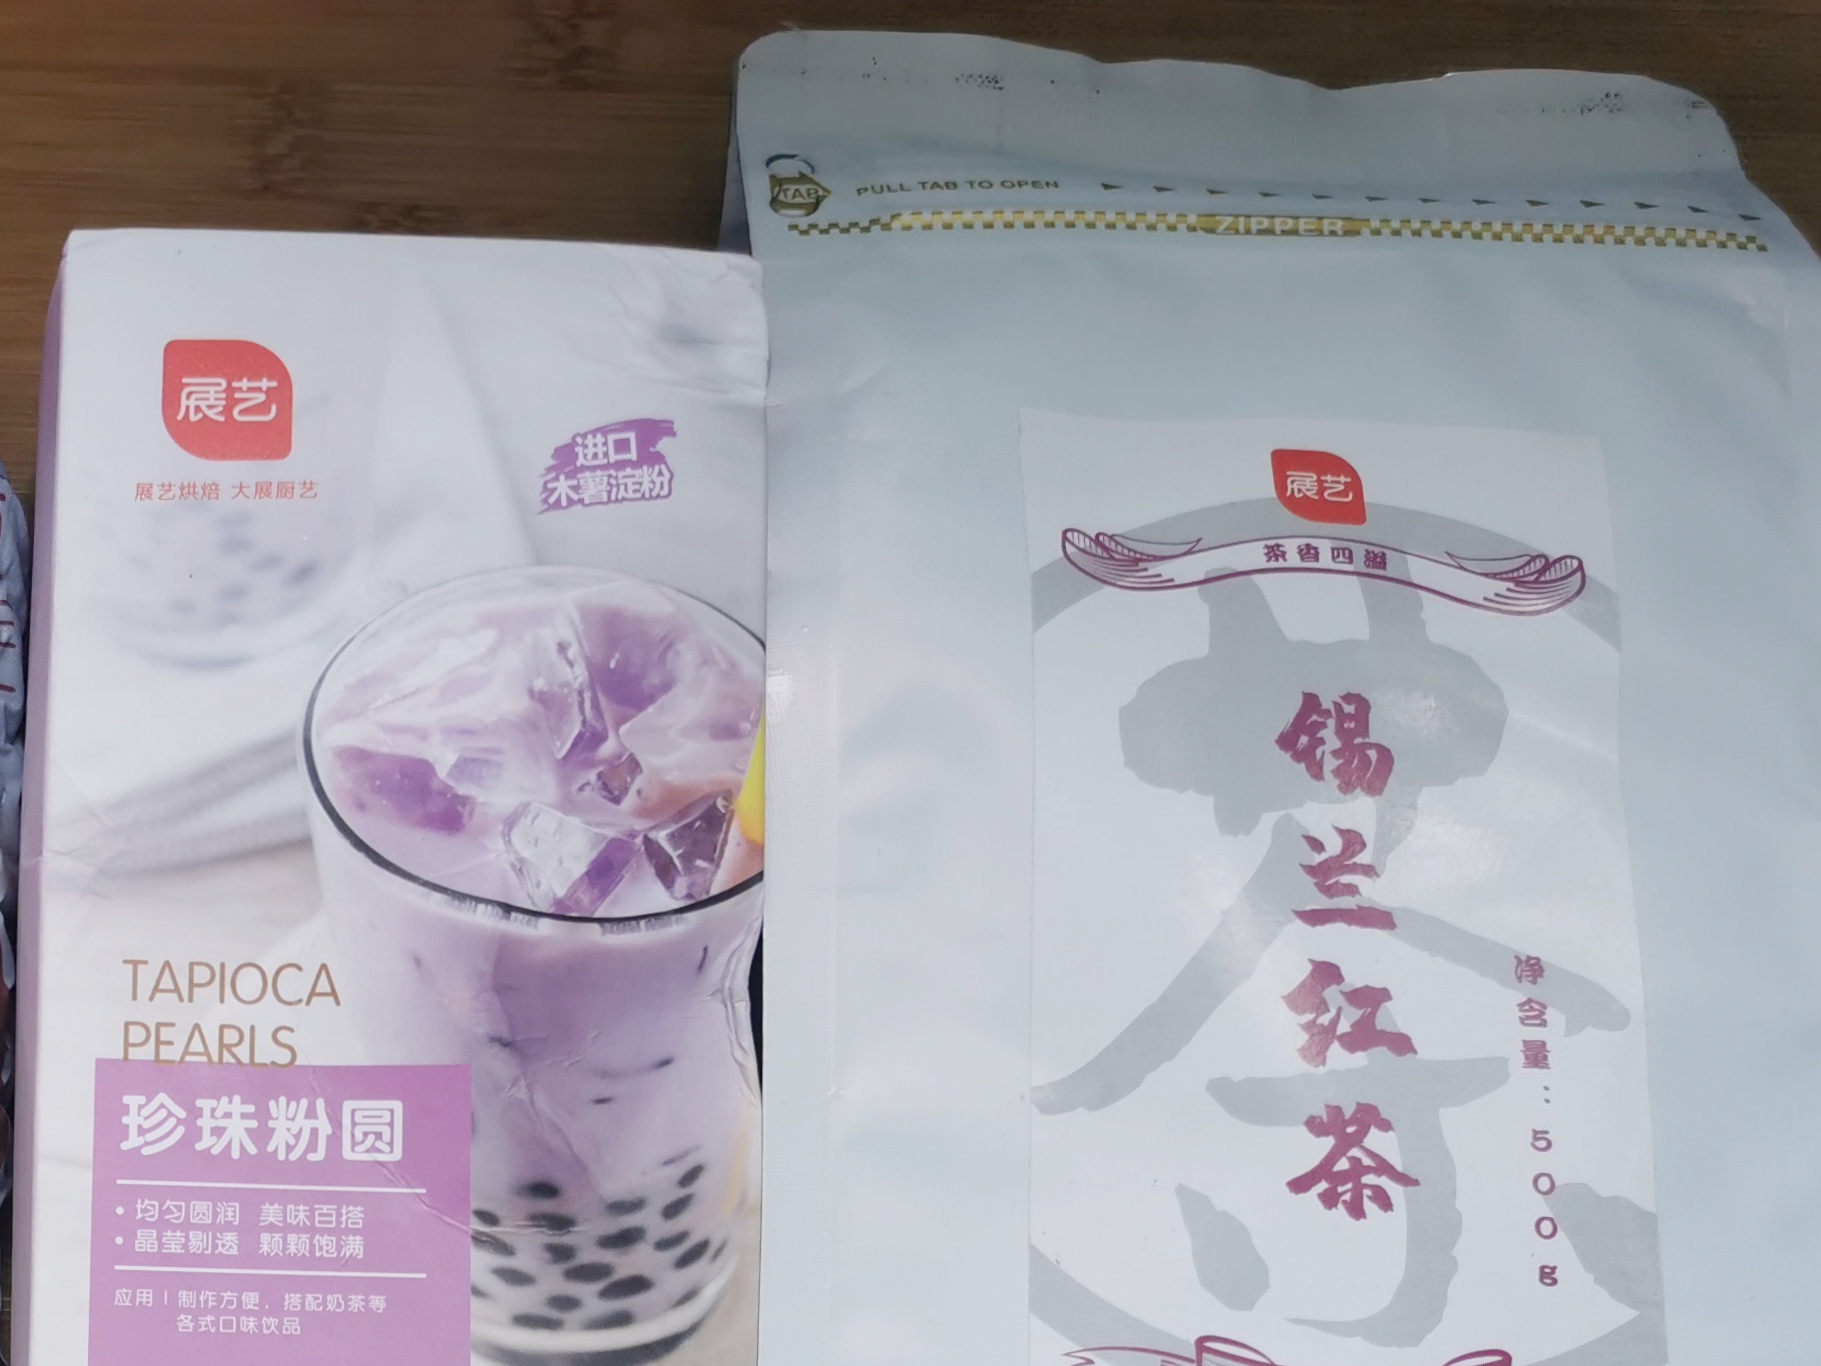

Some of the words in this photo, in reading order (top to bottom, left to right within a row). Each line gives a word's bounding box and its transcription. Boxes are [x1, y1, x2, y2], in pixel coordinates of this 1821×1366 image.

[856, 180, 912, 197] PULL
[917, 179, 960, 192] TAB
[964, 179, 994, 191] TO
[999, 179, 1060, 190] OPEN
[1215, 215, 1345, 236] ZIPPER
[176, 376, 278, 422] 展艺
[574, 431, 638, 467] 进口
[134, 481, 222, 502] 展艺烘焙
[231, 480, 319, 500] 大展厨艺
[546, 463, 671, 507] 木薯淀粉
[1286, 470, 1353, 503] 展艺
[1262, 543, 1388, 571] 茶香四溢
[1274, 690, 1421, 1222] 锡兰红茶
[121, 959, 342, 1007] TAPIOCA
[121, 1020, 299, 1068] PEARLS
[119, 1092, 403, 1163] 珍珠粉圆
[135, 1198, 240, 1226] 均匀圆润
[258, 1202, 365, 1229] 美味百搭
[134, 1229, 240, 1256] 晶莹剔透
[258, 1232, 365, 1260] 颗颗饱满
[176, 1313, 301, 1335] 各式口味饮品
